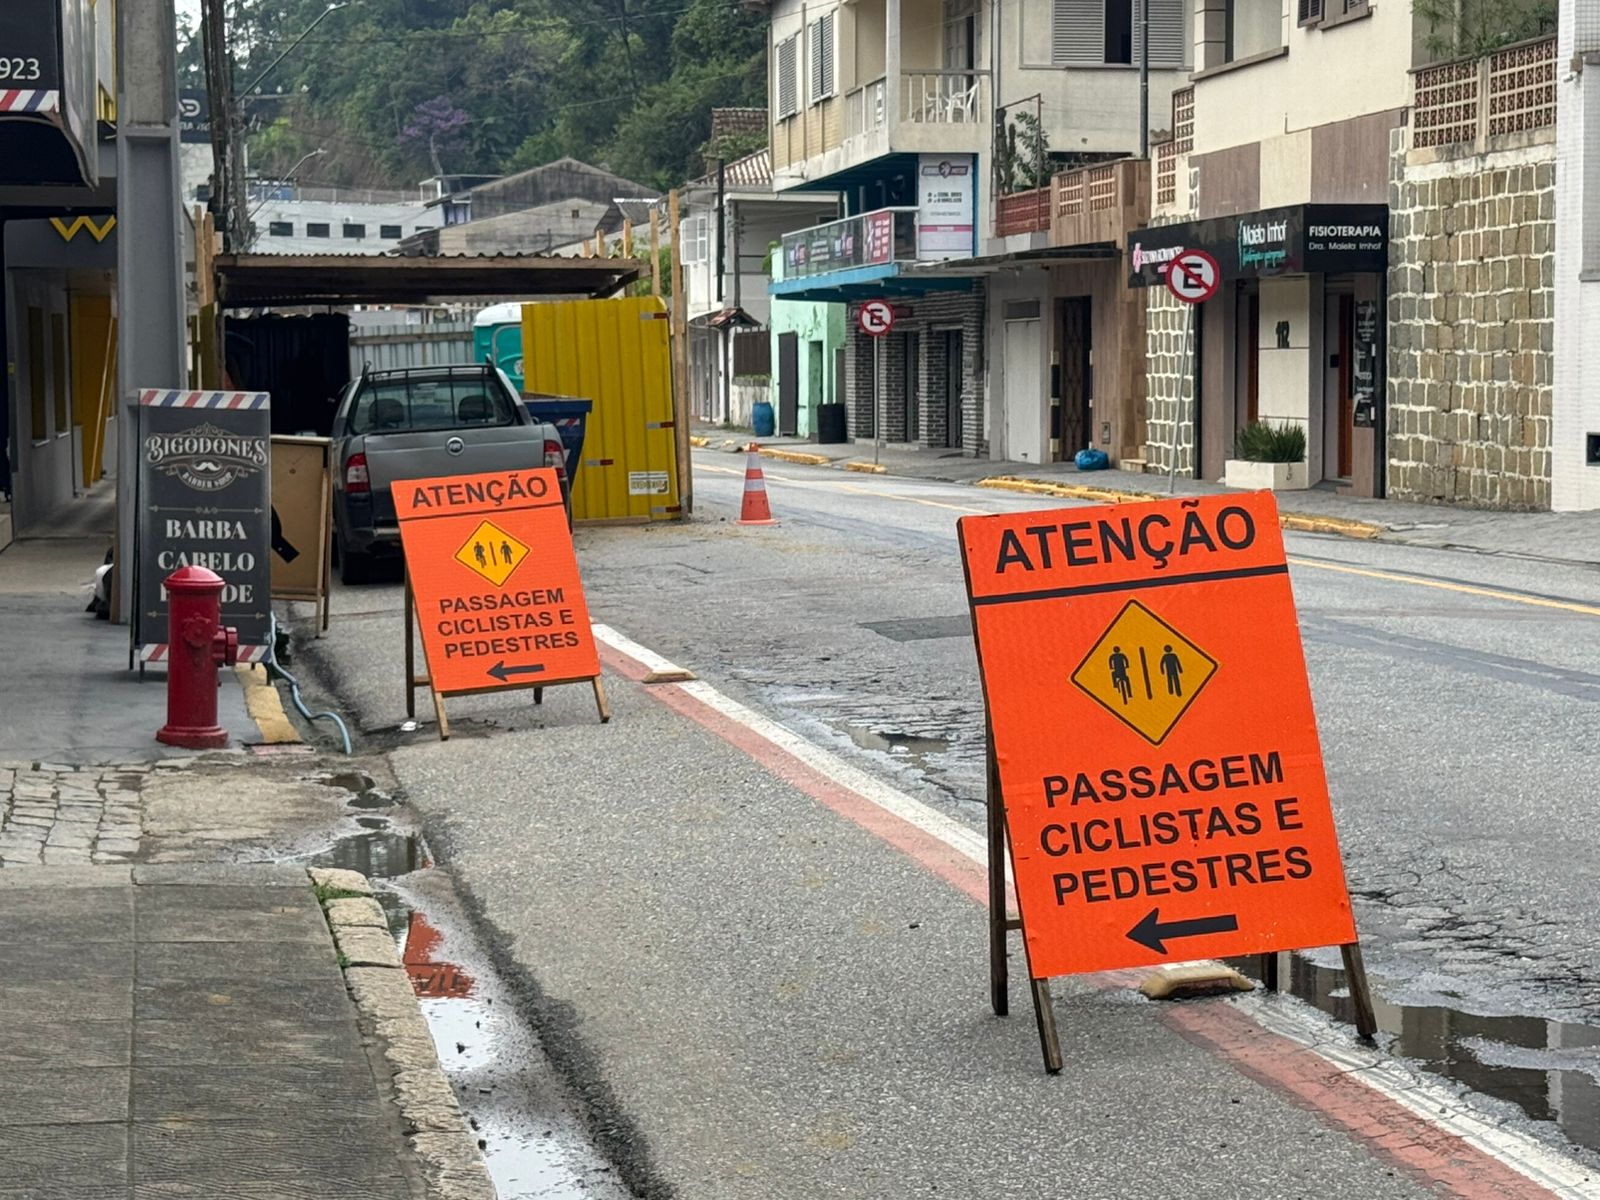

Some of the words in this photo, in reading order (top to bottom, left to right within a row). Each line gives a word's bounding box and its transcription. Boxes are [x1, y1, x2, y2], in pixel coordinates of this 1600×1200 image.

[0, 57, 41, 80] 923
[1266, 219, 1287, 243] Imhof
[1309, 225, 1382, 237] FISIOTERAPIA
[1359, 242, 1382, 250] Imhof
[145, 436, 268, 466] BIGODONES
[411, 474, 548, 507] ATENÇÃO
[165, 519, 248, 540] BARBA
[995, 499, 1256, 574] ATENÇÃO
[157, 550, 256, 572] CABELO
[439, 587, 564, 614] PASSAGEM
[437, 611, 553, 637] CICLISTAS
[559, 609, 575, 625] E
[444, 631, 579, 659] PEDESTRES
[1043, 751, 1284, 808] PASSAGEM
[1040, 802, 1263, 858] CICLISTAS
[1274, 797, 1303, 831] E
[1053, 846, 1311, 906] PEDESTRES
